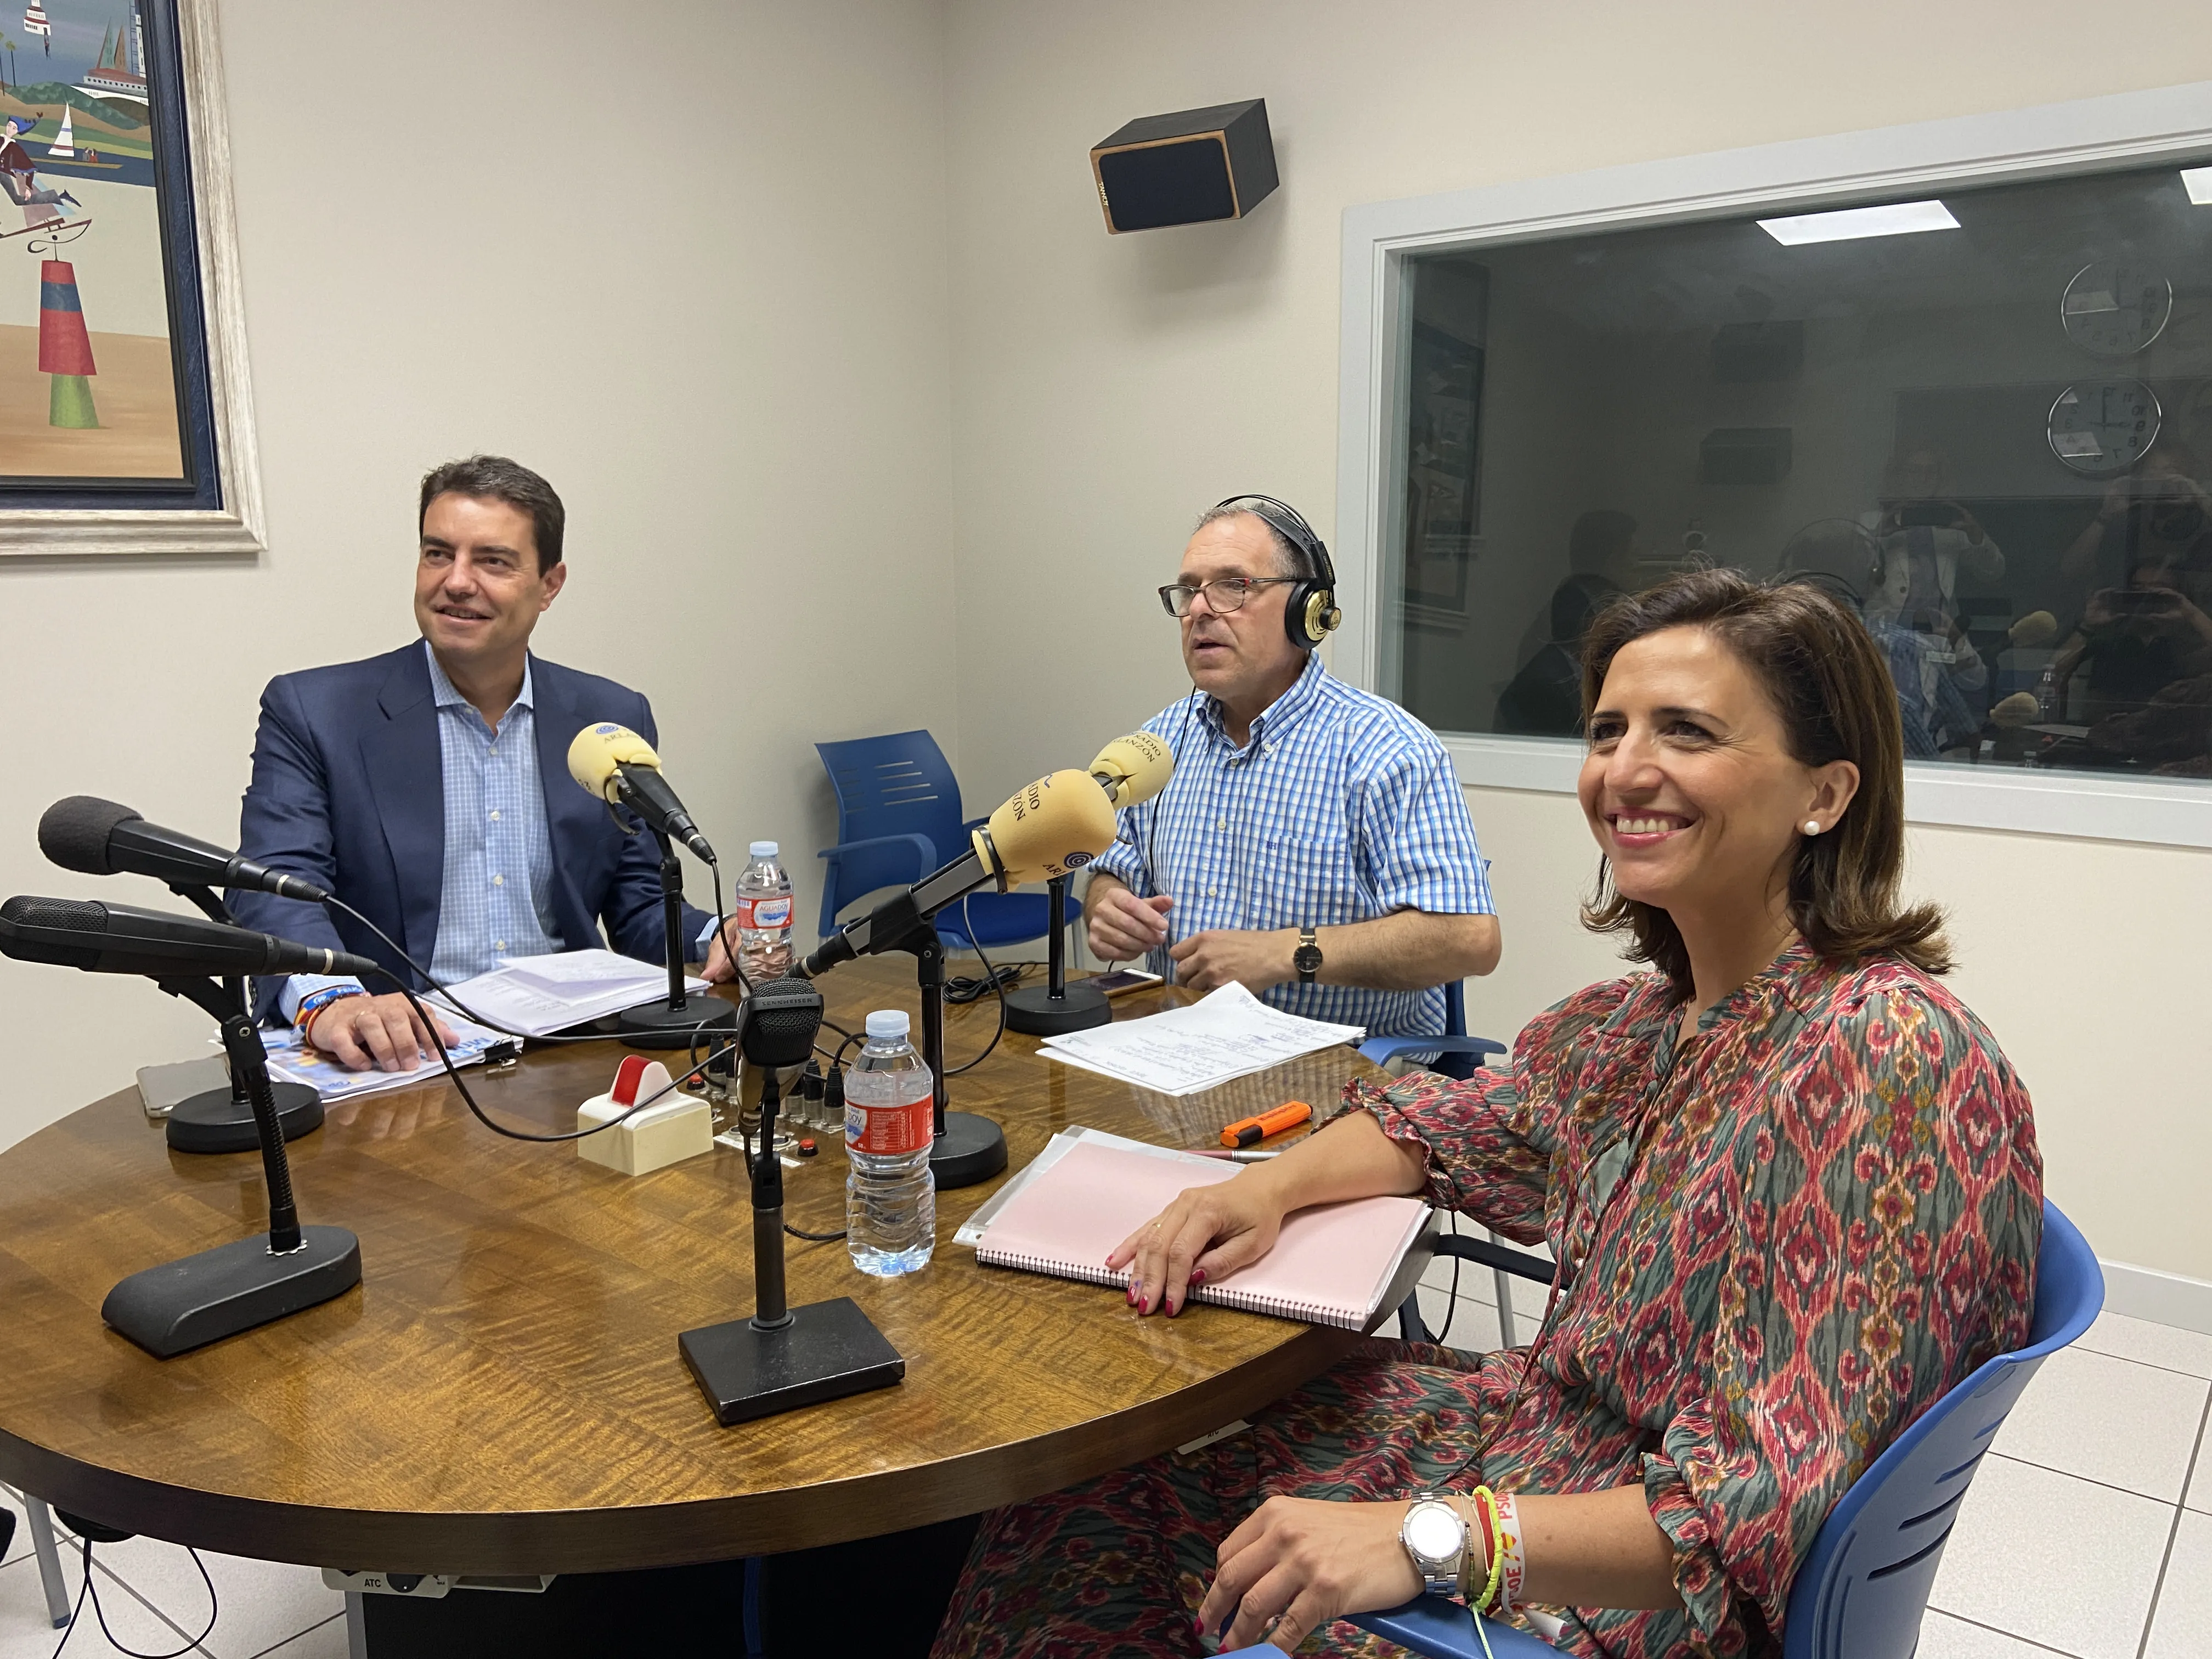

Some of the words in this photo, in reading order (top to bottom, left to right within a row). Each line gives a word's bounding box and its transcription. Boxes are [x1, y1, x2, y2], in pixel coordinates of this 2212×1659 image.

[1133, 735, 1161, 756] RADIO
[1028, 782, 1040, 810] ADIO
[761, 998, 812, 1006] SENNHEISER
[364, 1578, 381, 1587] ATC
